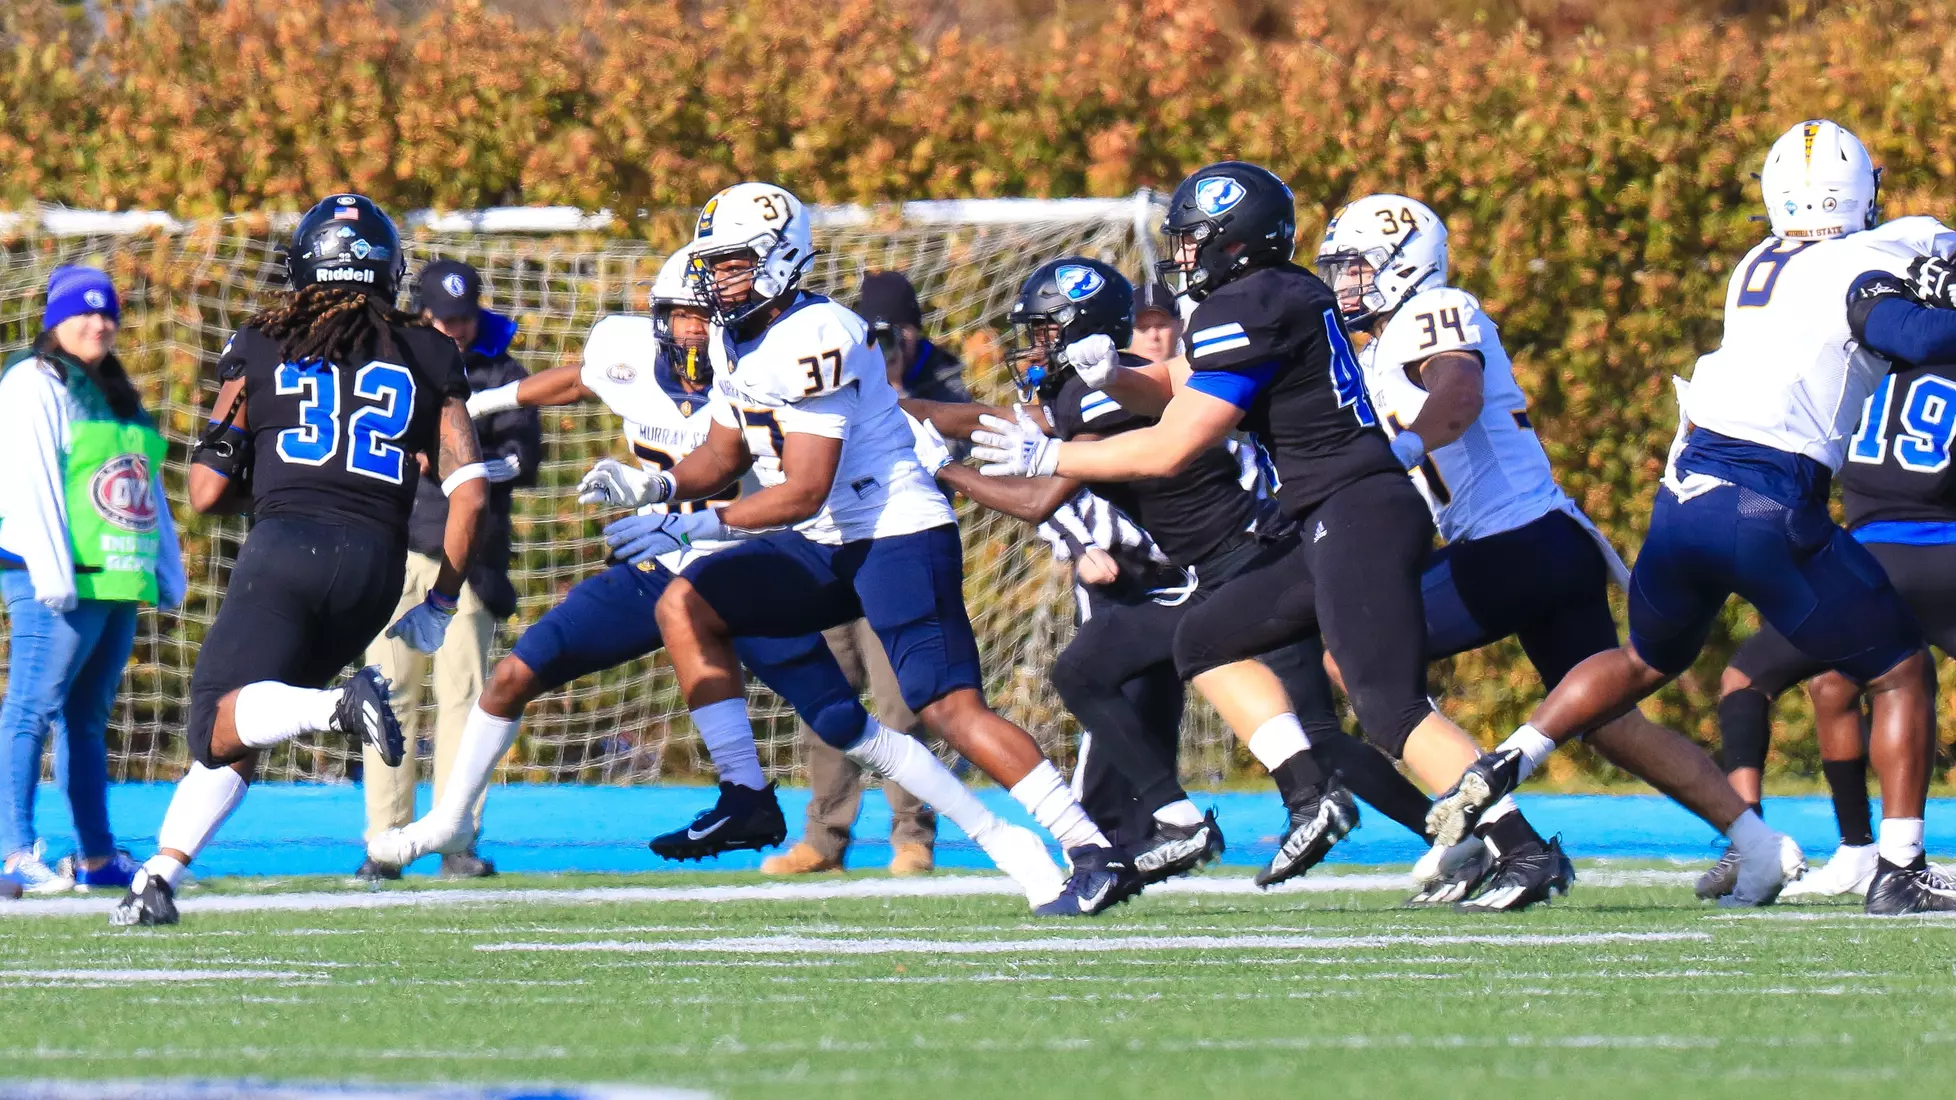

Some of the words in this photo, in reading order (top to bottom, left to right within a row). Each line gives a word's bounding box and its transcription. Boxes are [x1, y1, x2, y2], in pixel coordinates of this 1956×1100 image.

[753, 193, 794, 222] 37
[1375, 207, 1418, 235] 34
[1816, 226, 1843, 237] STATE
[338, 252, 352, 263] 32
[316, 267, 375, 284] Riddell
[1415, 306, 1466, 351] 34
[797, 349, 843, 396] 37
[1323, 308, 1377, 428] 4
[274, 358, 416, 485] 32
[639, 423, 687, 447] MURRAY
[1848, 372, 1956, 474] 19
